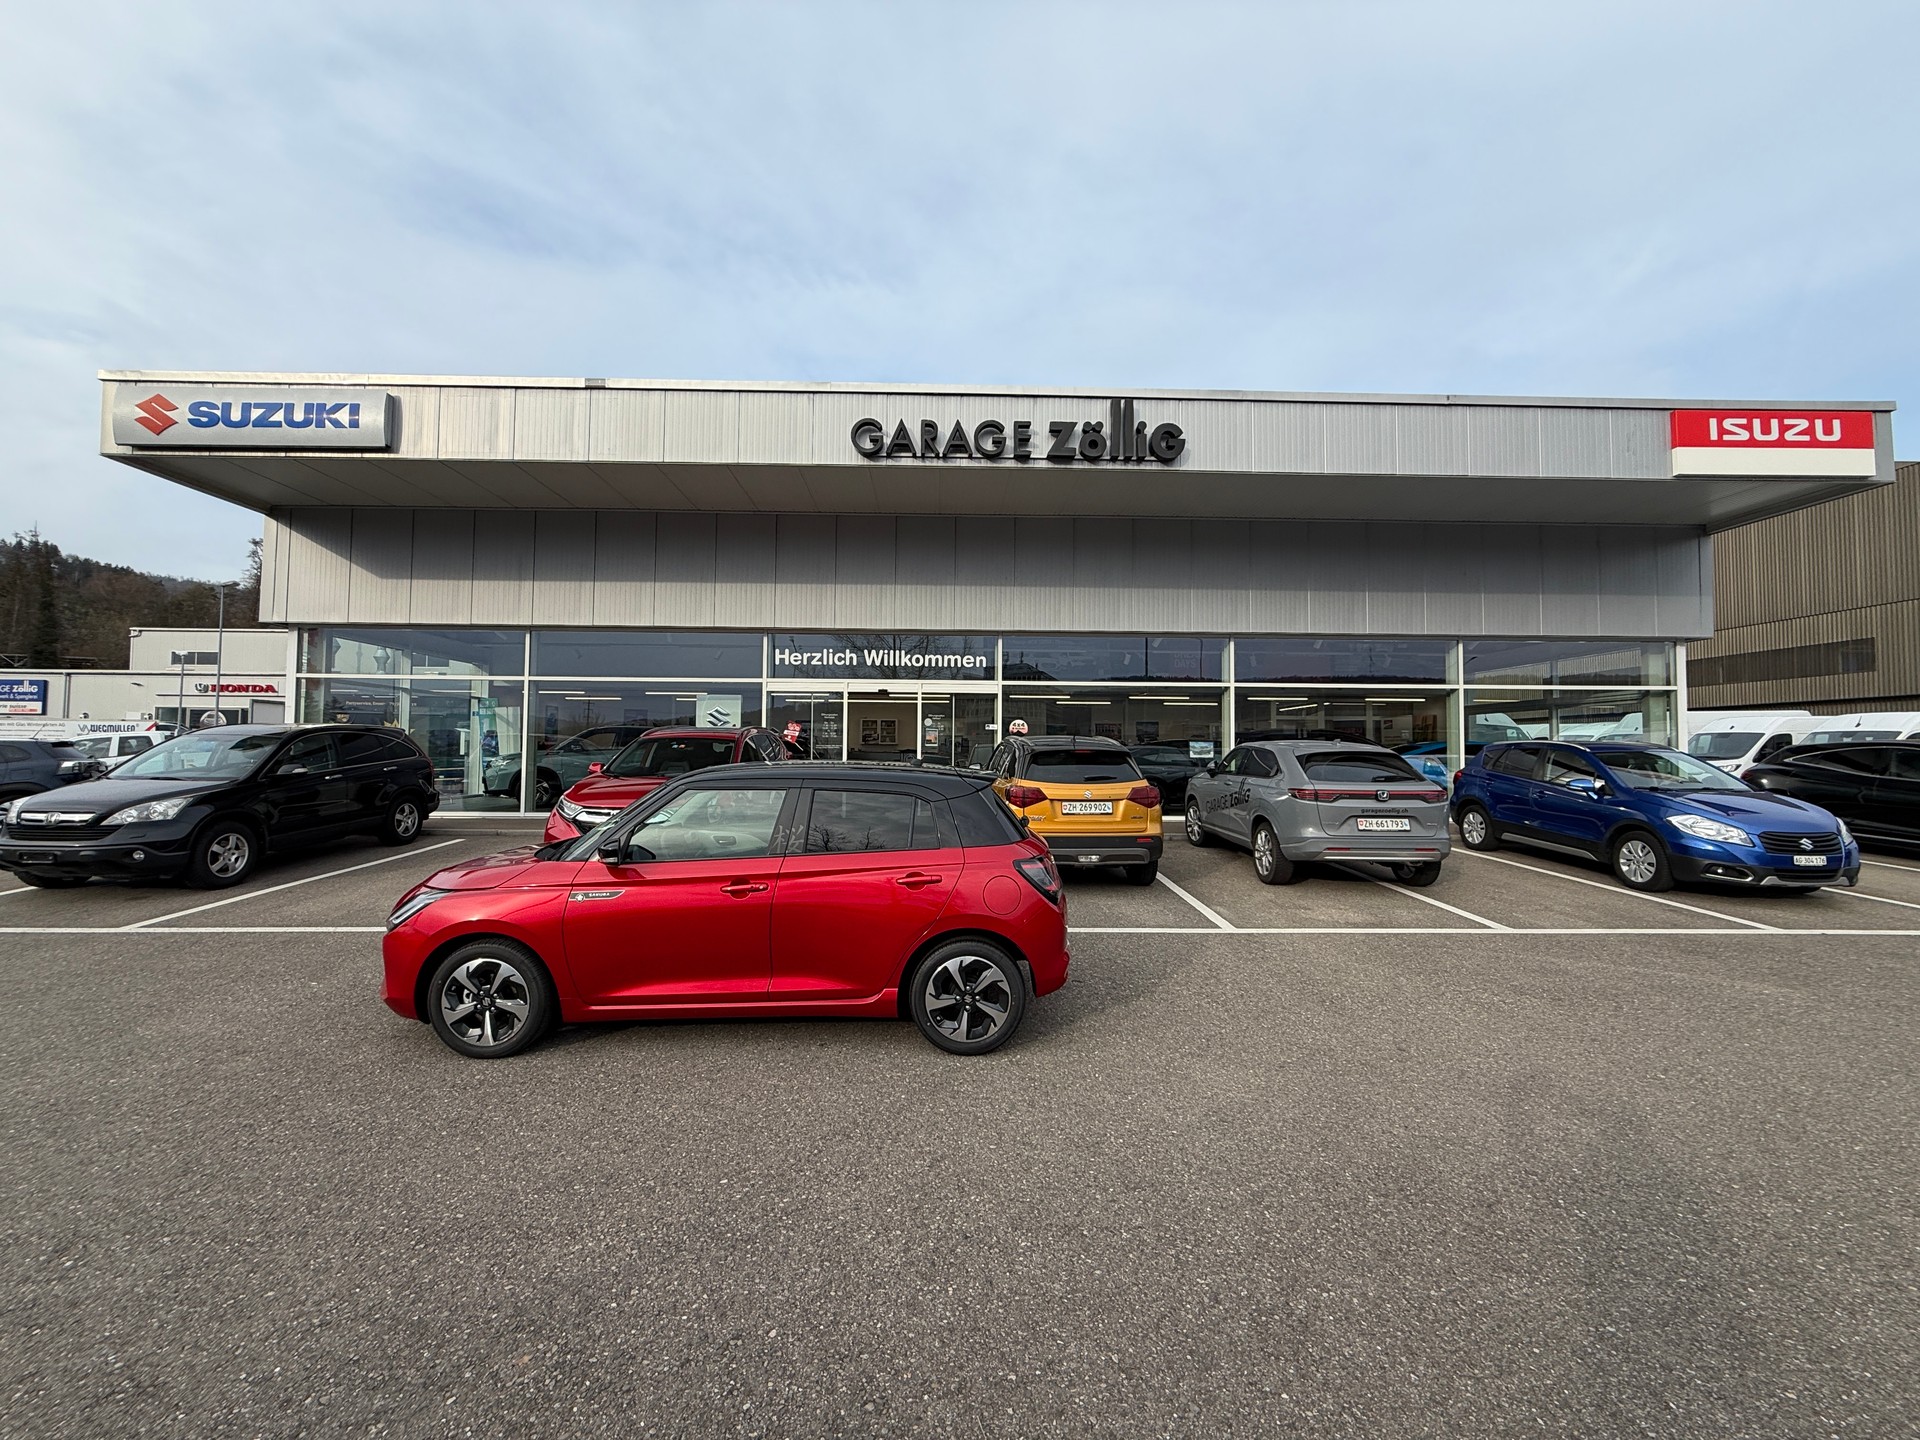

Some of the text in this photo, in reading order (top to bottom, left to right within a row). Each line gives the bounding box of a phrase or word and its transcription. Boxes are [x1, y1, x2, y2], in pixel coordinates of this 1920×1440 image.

[187, 401, 360, 429] SUZUKI
[850, 417, 1032, 460] GARAGE
[1709, 417, 1841, 442] ISUZU
[775, 648, 987, 667] Herzlich Willkommen
[209, 684, 278, 693] HONDA
